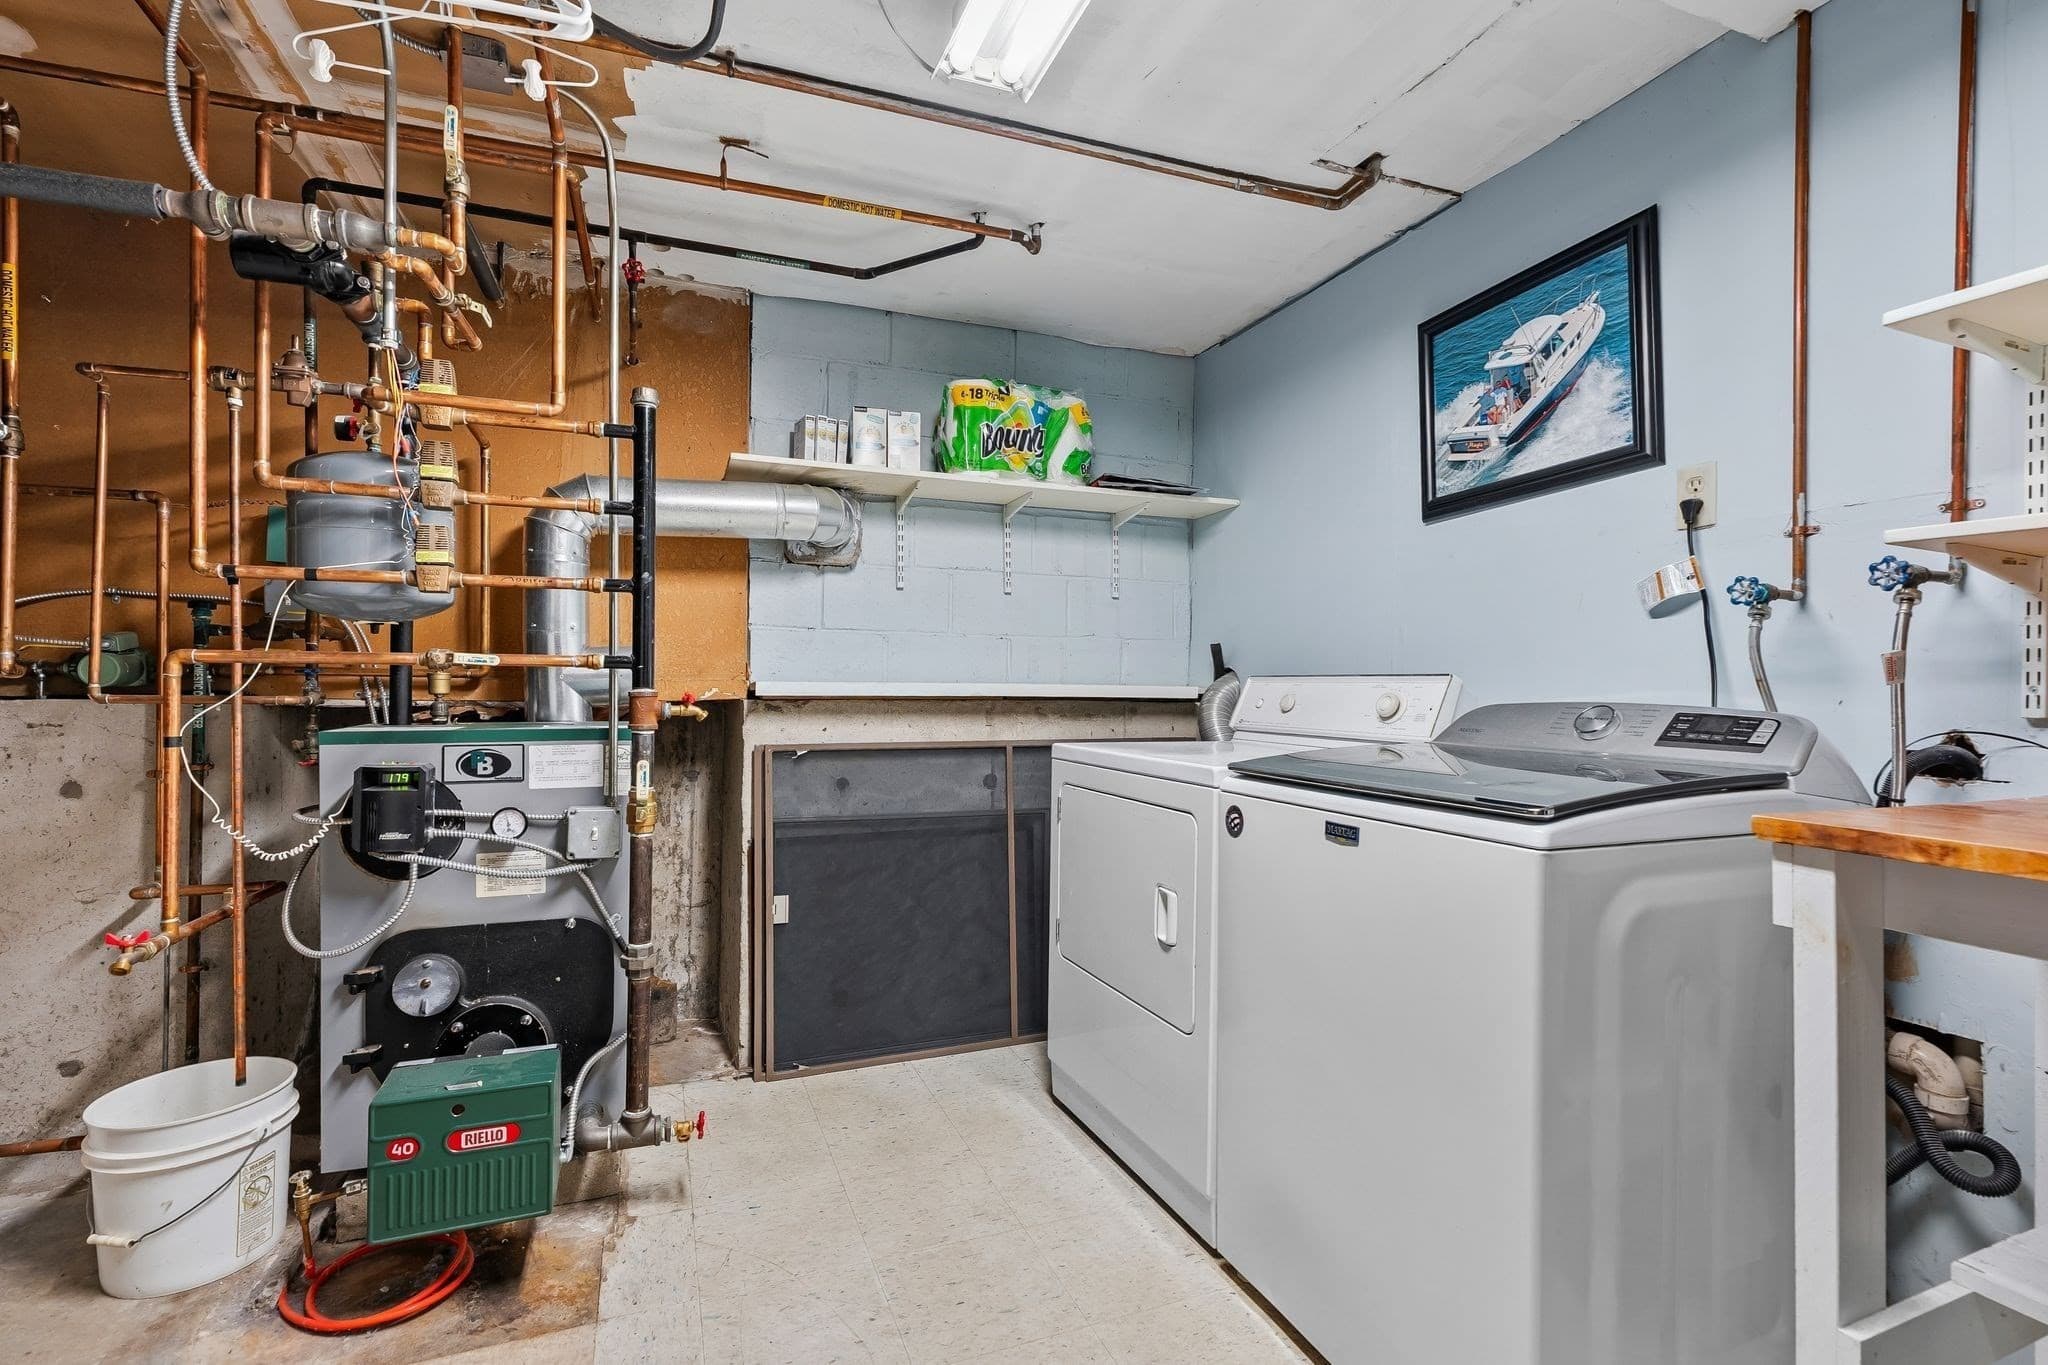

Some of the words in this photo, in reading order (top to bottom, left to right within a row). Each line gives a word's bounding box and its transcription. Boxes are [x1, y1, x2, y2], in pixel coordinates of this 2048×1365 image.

[828, 198, 861, 211] DOMESTIC
[861, 204, 873, 214] HOT
[875, 207, 897, 219] WATER
[2, 269, 13, 308] DOMESTIC
[2, 309, 13, 325] HOT
[2, 327, 13, 353] WATER
[304, 323, 315, 355] DOMESTIC
[981, 422, 1045, 458] Bounty
[193, 664, 204, 690] OMESTIC
[389, 773, 409, 784] 179
[391, 1142, 415, 1156] 40
[464, 1129, 504, 1146] RIELLO
